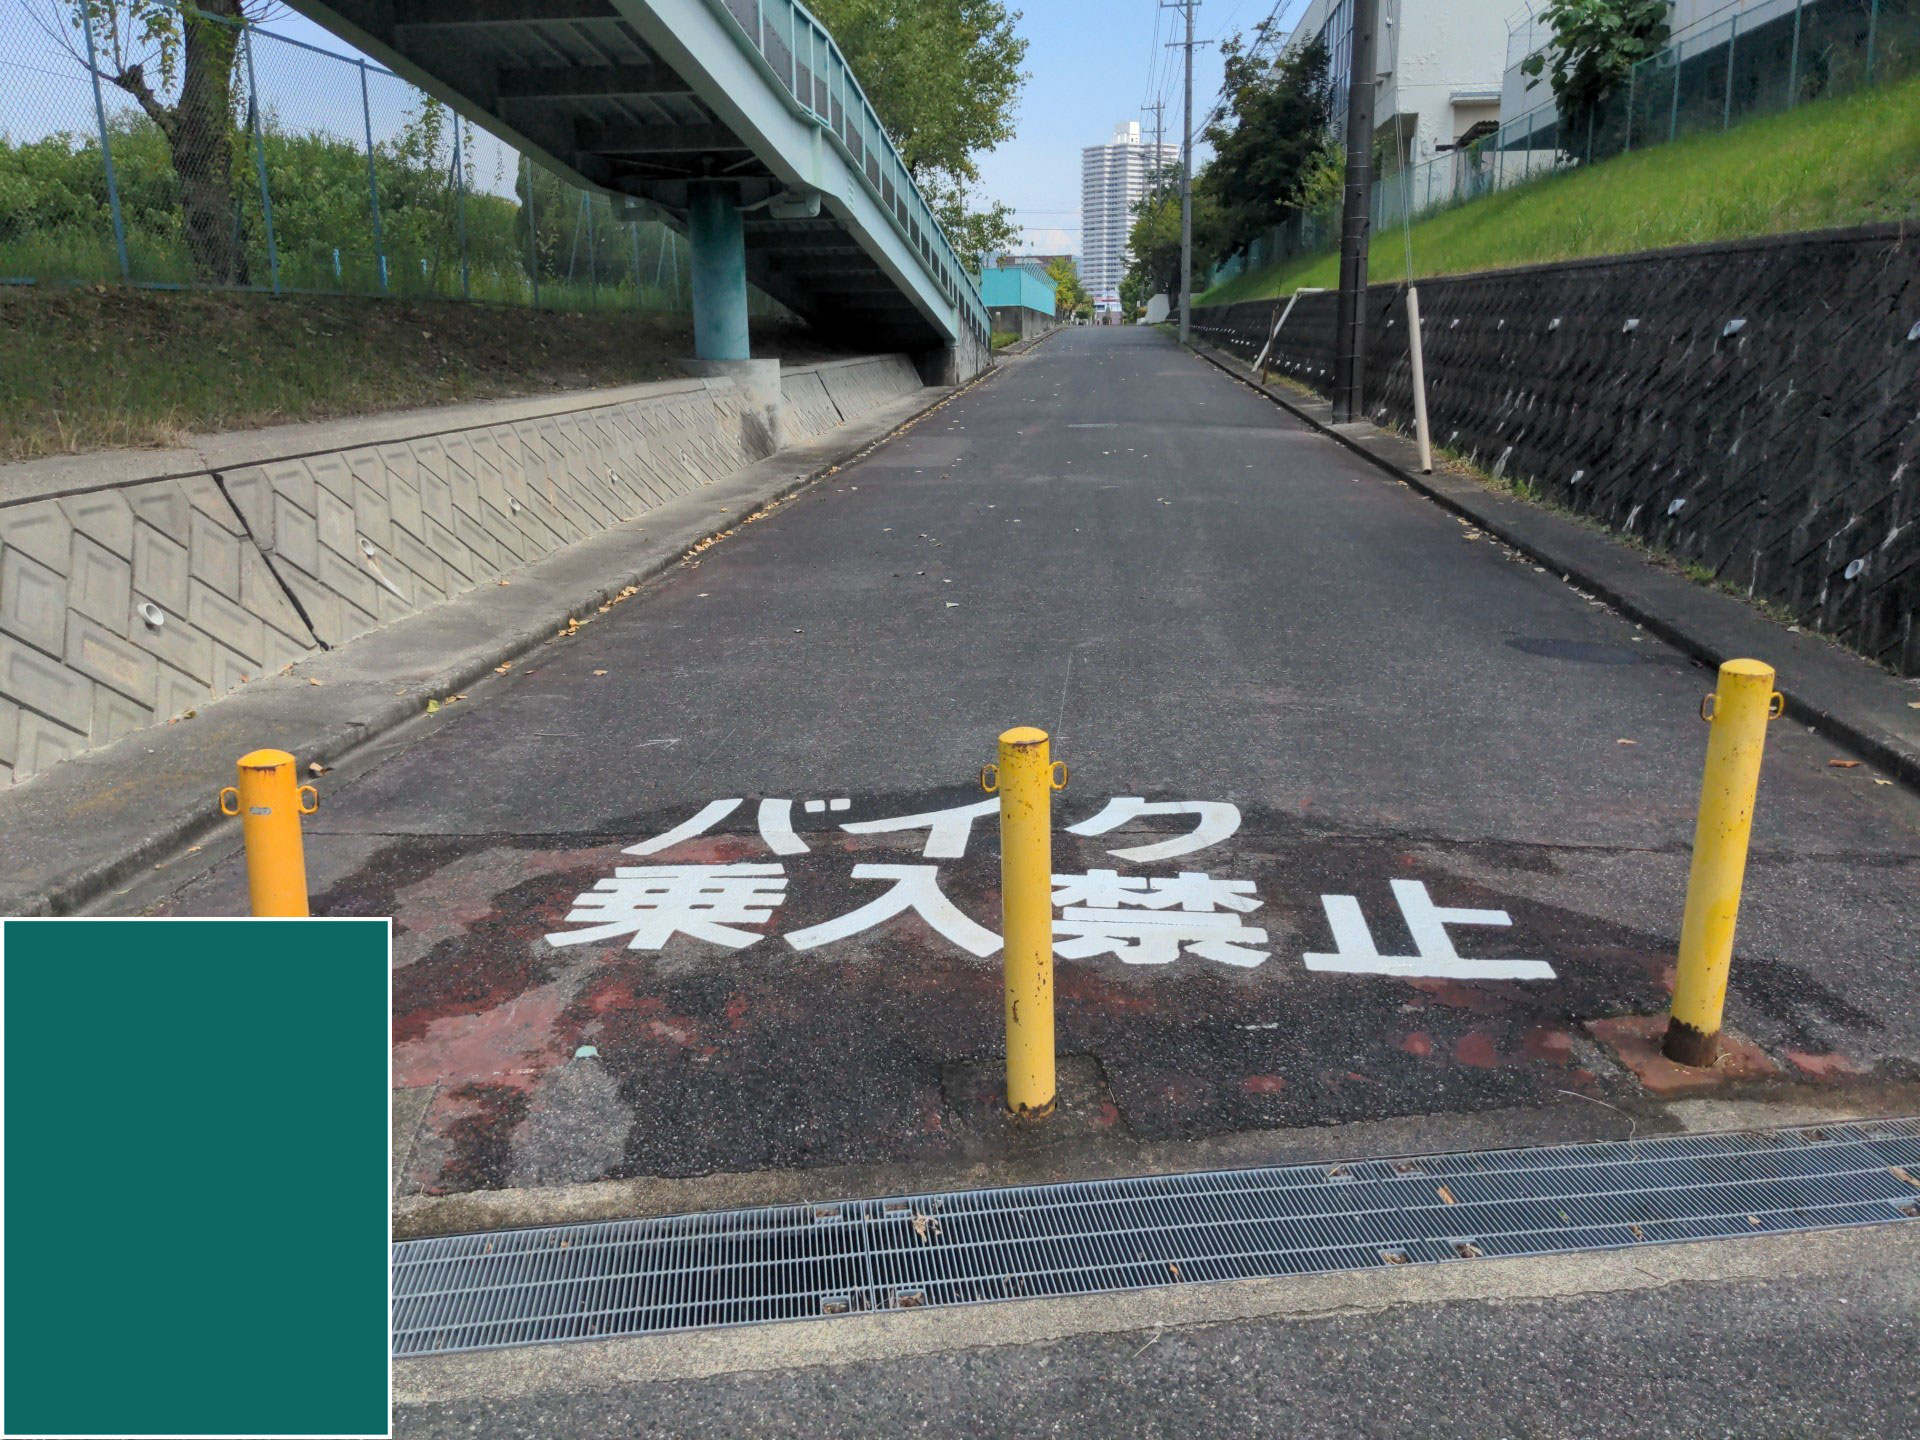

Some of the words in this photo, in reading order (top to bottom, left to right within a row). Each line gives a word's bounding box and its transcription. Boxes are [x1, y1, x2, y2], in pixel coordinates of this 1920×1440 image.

[620, 797, 1243, 863] バイク
[544, 862, 1557, 981] 乗入禁止
